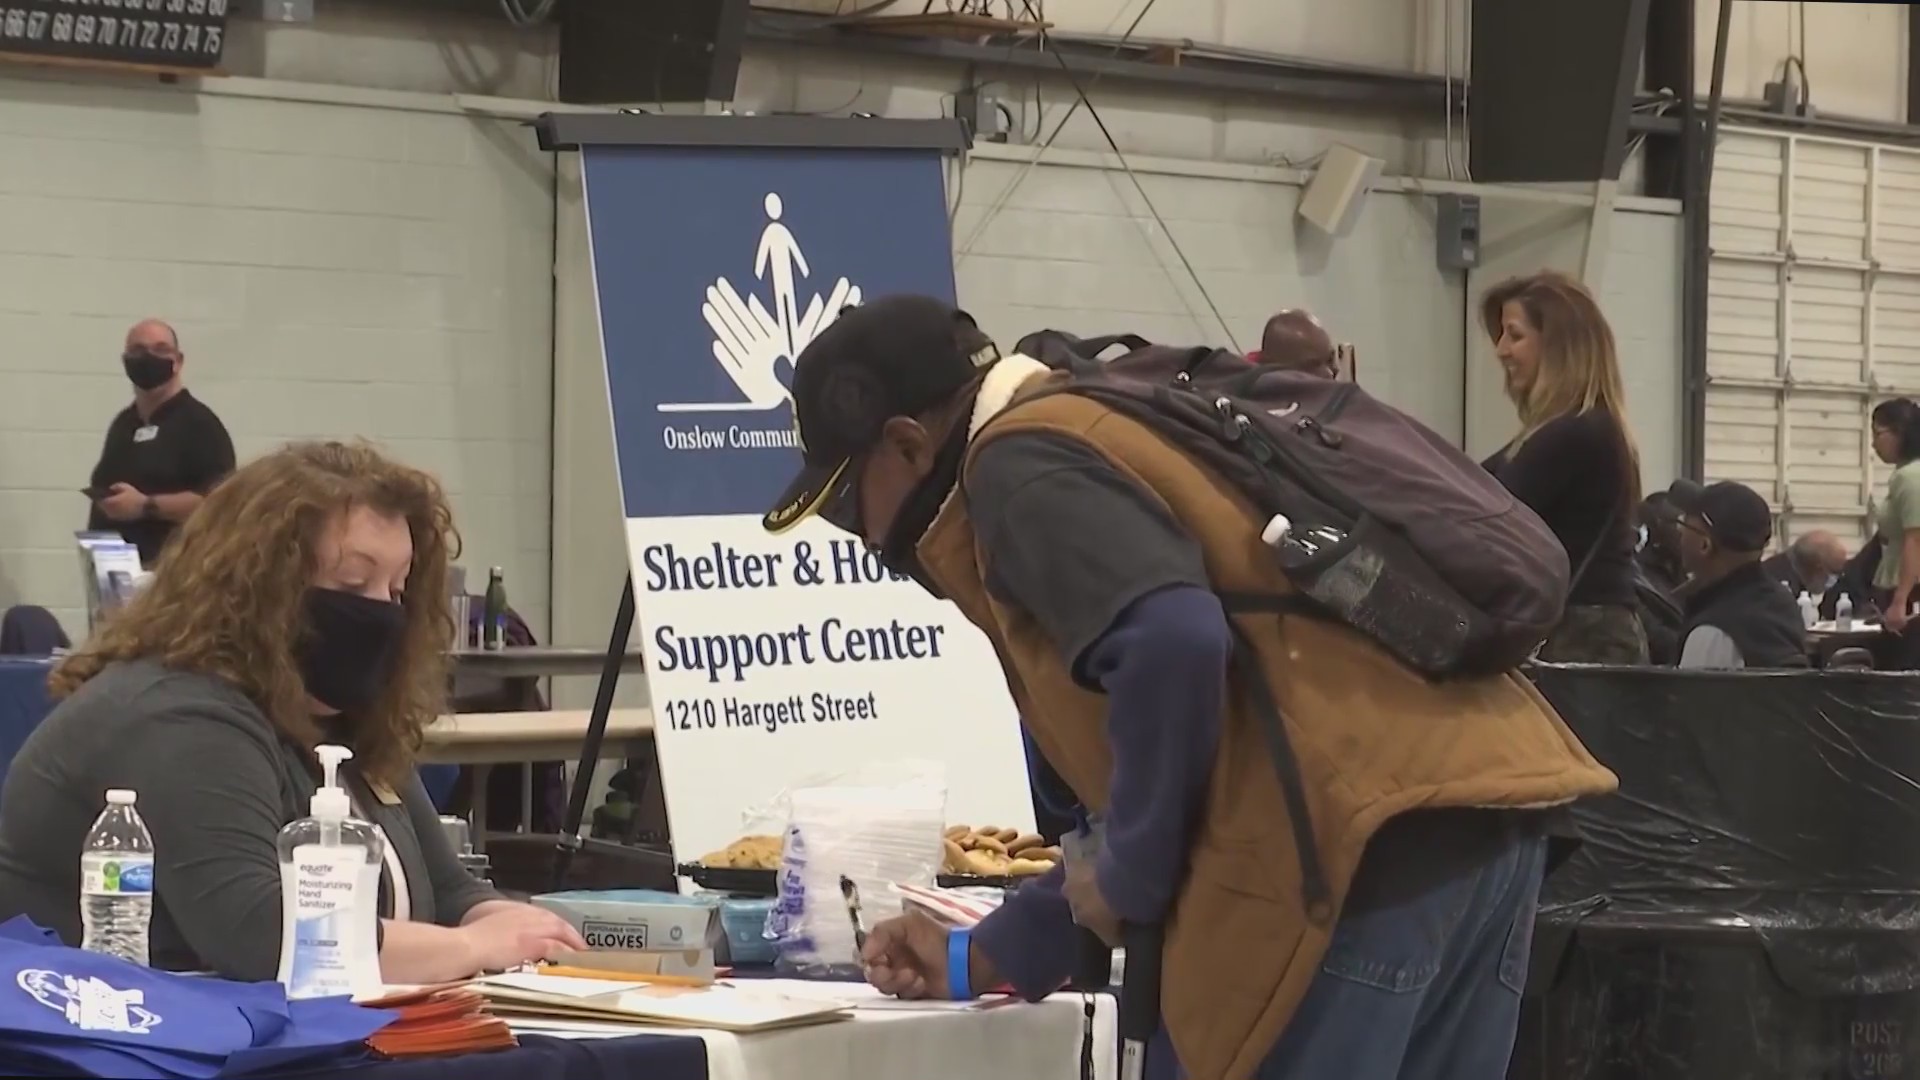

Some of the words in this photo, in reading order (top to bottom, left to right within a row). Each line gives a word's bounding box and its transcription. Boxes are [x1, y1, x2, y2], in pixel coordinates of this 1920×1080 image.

[5, 9, 26, 37] 66
[27, 11, 48, 39] 67
[52, 13, 73, 42] 68
[75, 15, 96, 43] 69
[98, 17, 117, 45] 70
[120, 18, 137, 47] 71
[140, 20, 158, 49] 72
[161, 22, 180, 50] 73
[182, 24, 200, 52] 74
[204, 26, 221, 54] 75
[664, 425, 725, 449] Onslow
[644, 541, 782, 592] Shelter
[793, 540, 824, 586] &
[828, 539, 909, 585] Ho
[655, 622, 815, 683] Support
[821, 617, 944, 663] Center
[665, 698, 716, 731] 1210
[722, 694, 806, 733] Hargett
[811, 690, 878, 722] Street
[300, 864, 333, 874] equate
[298, 879, 353, 891] Moisturizing
[298, 890, 322, 898] Hand
[298, 898, 336, 909] Sanitizer
[585, 932, 644, 949] GLOVES
